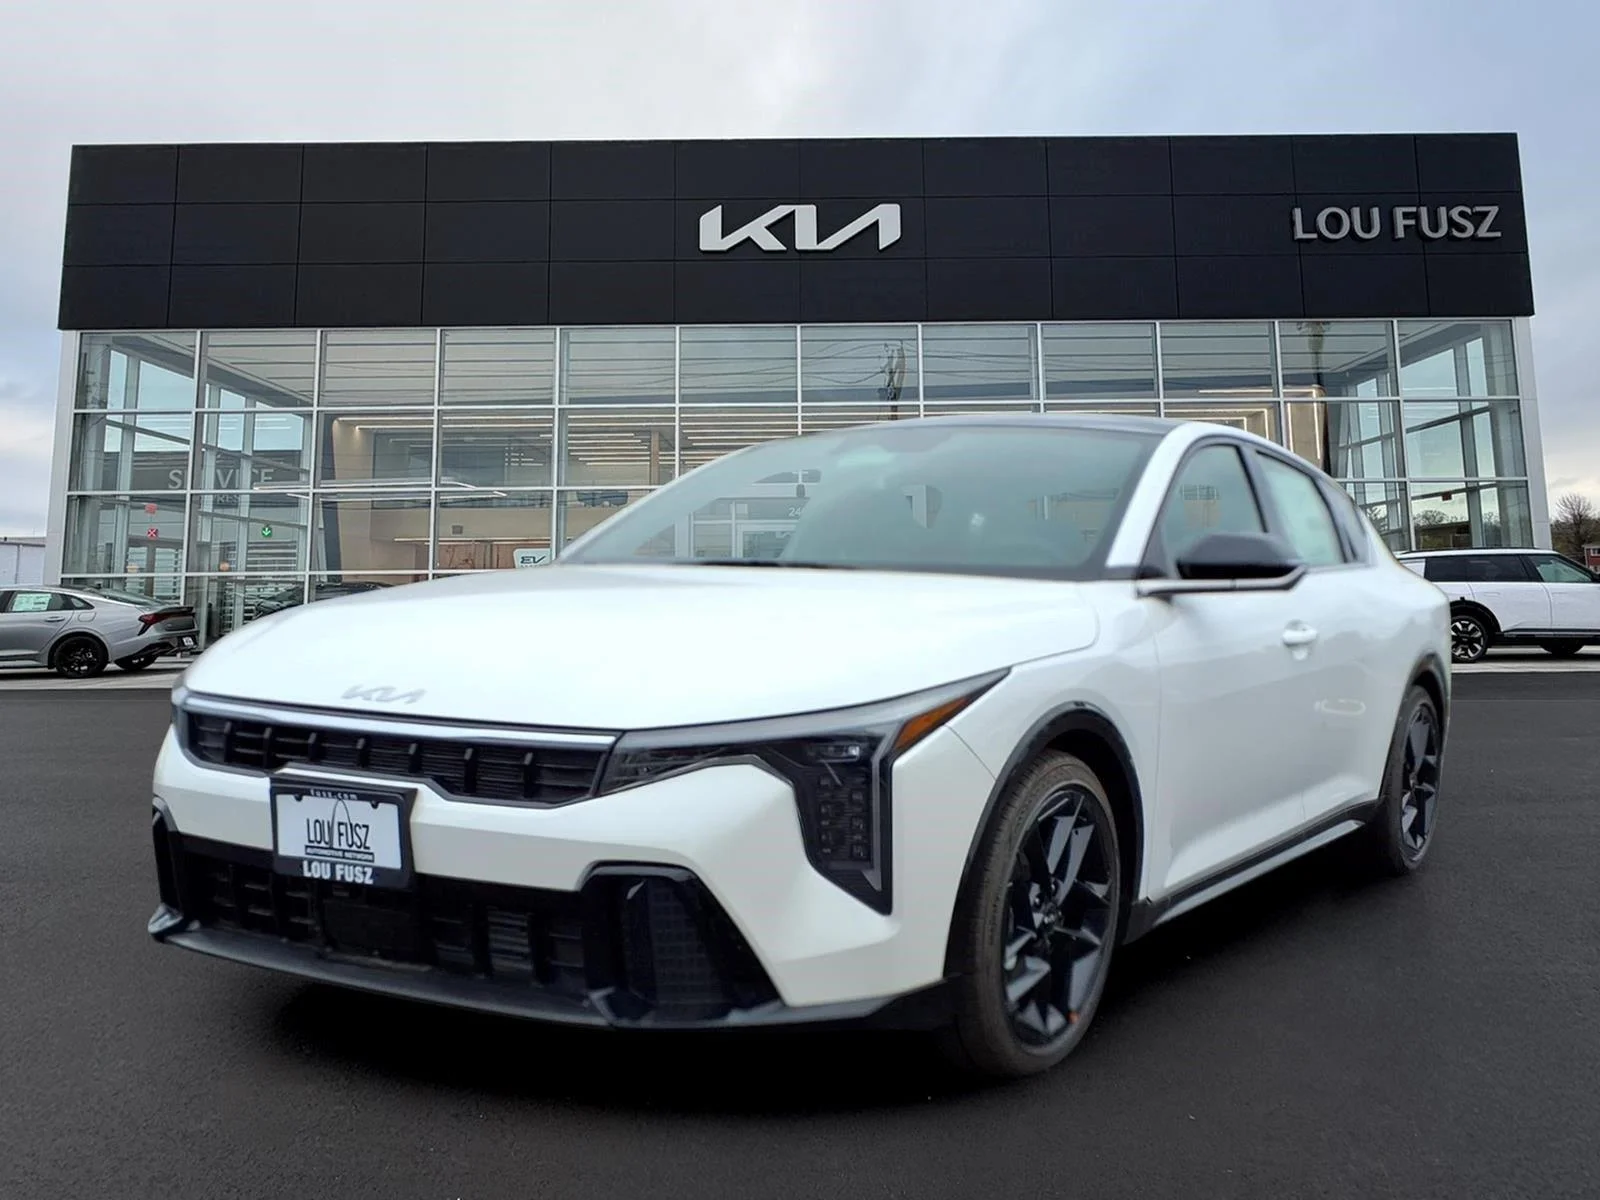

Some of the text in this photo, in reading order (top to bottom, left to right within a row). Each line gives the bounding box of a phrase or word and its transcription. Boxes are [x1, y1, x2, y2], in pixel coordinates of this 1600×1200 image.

[699, 203, 901, 251] KIA
[1293, 205, 1502, 240] LOU FUSZ
[168, 469, 274, 489] SVIE
[341, 684, 427, 705] KIA
[306, 818, 371, 850] LOU FUSZ
[302, 860, 374, 885] LOU FUSZ
